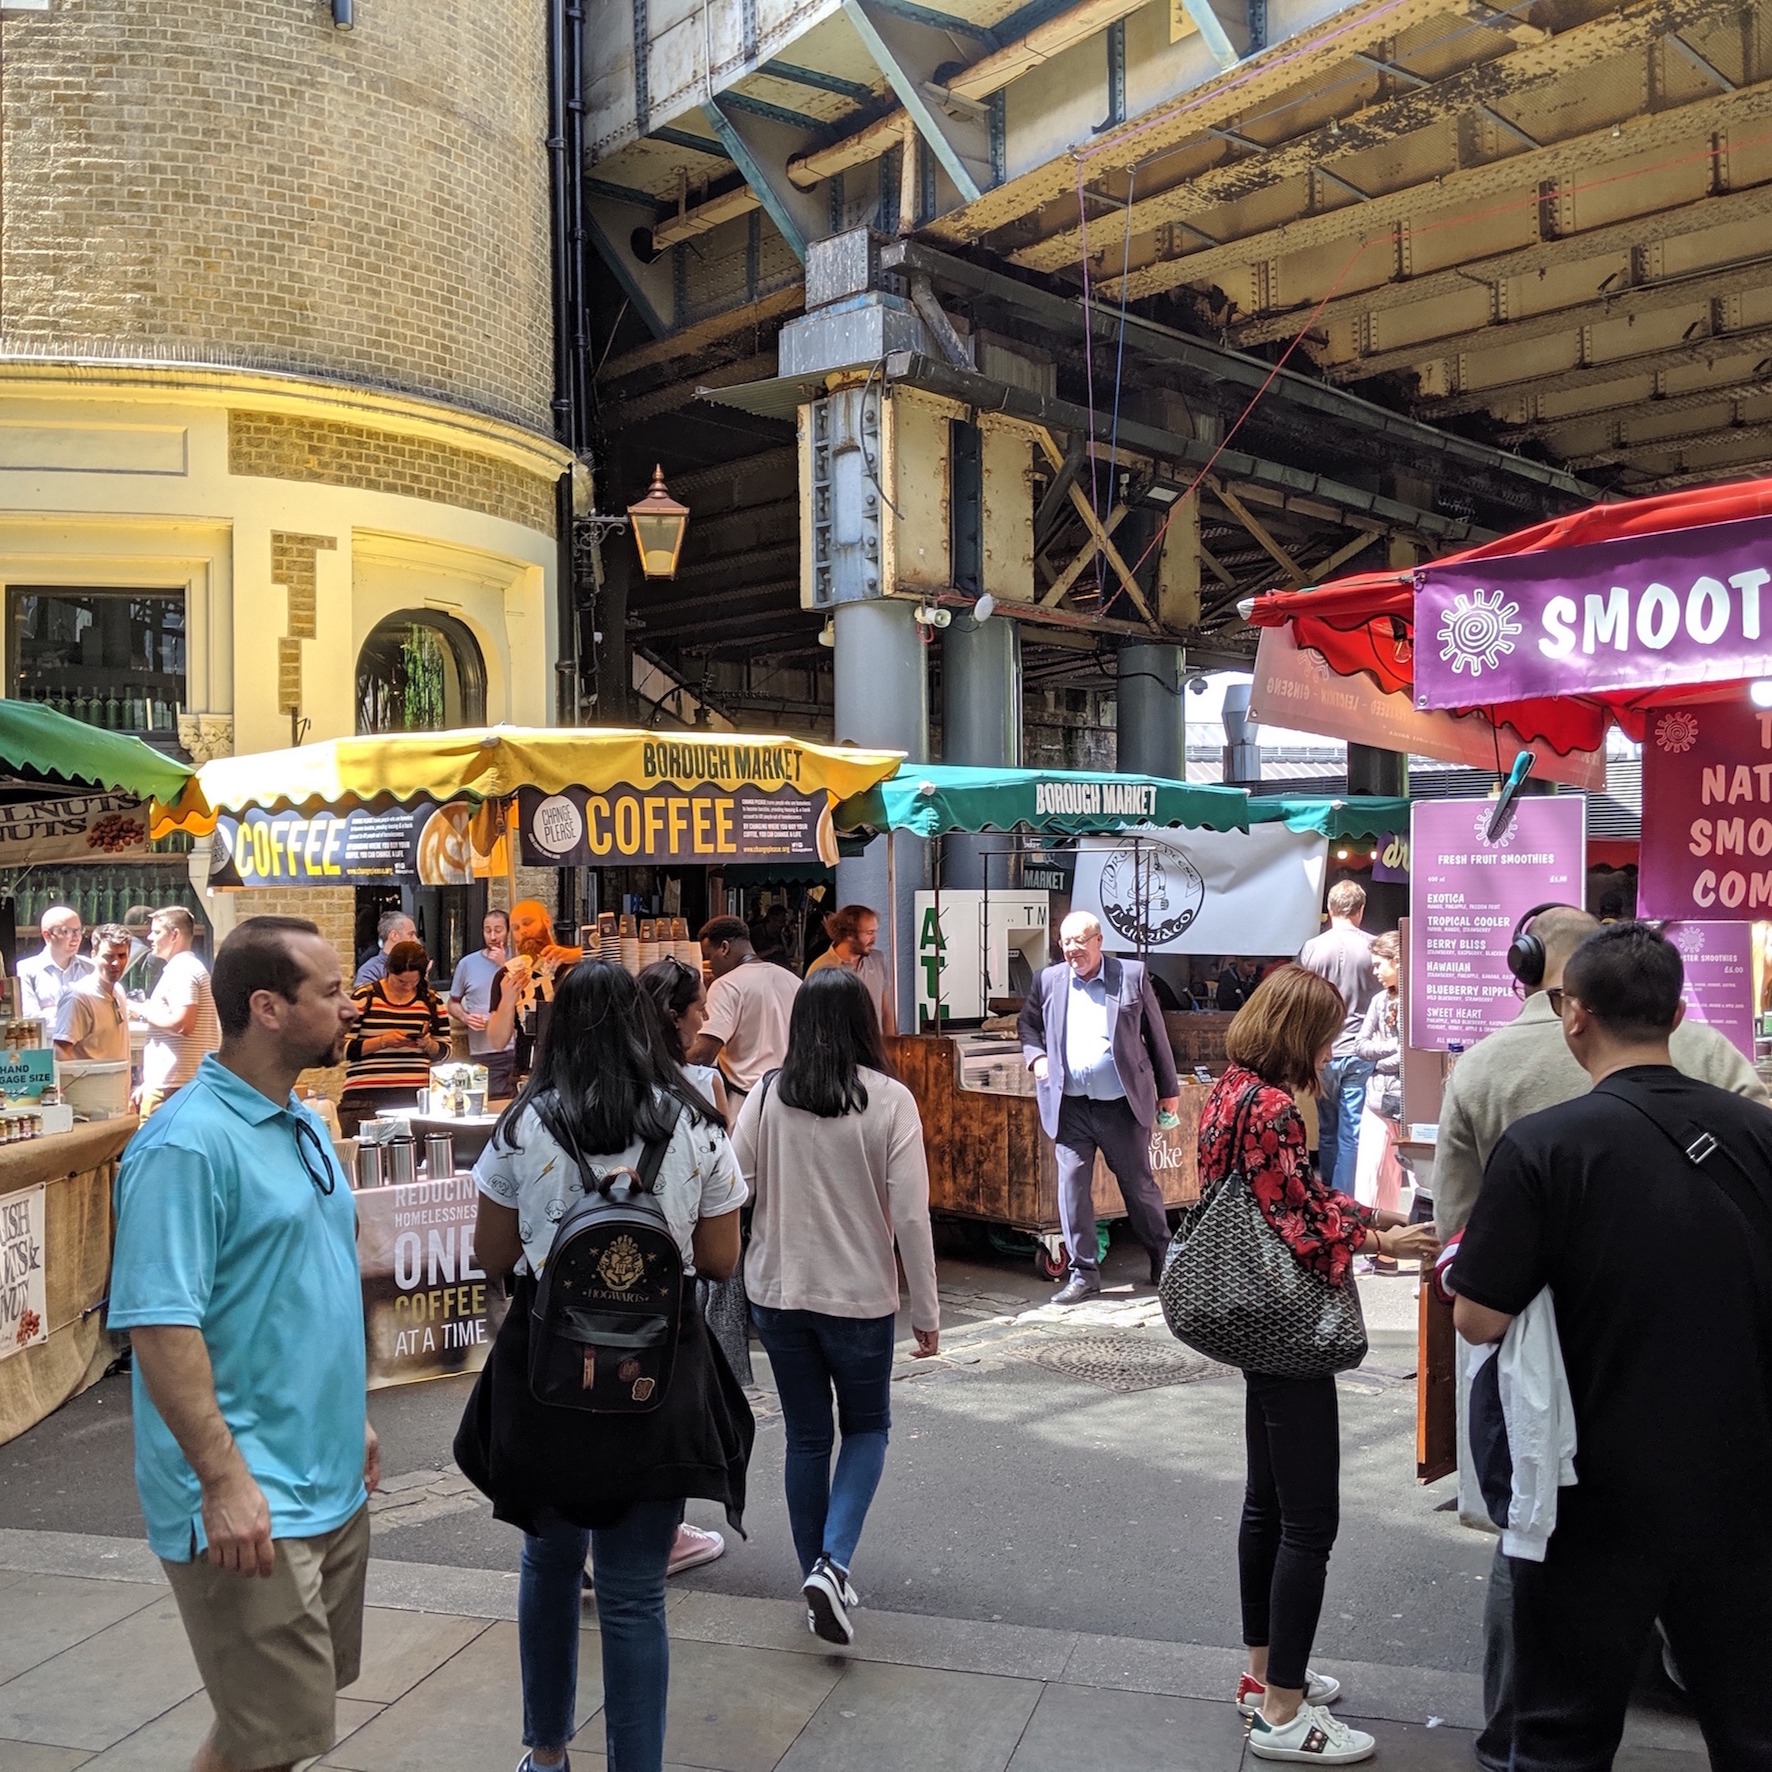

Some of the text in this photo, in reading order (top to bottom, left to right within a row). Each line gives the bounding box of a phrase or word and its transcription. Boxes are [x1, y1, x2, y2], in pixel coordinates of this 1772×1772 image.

[1538, 568, 1771, 659] SMOOT
[643, 742, 803, 782] BOROUGH MARKET
[1701, 764, 1772, 806] NAT
[1036, 783, 1157, 815] BOROUGH MARKET
[541, 804, 572, 826] CHANGE
[585, 795, 737, 856] COFFEE
[0, 818, 87, 842] UTS
[544, 821, 576, 844] PLEASE
[1689, 817, 1772, 857] SMO
[234, 819, 346, 878] COFFEE
[1438, 853, 1555, 864] FRESH FRUIT SMOOTHIES
[1023, 869, 1065, 891] MARKET
[1692, 868, 1772, 909] COM
[1427, 893, 1464, 903] EXOTICA
[1427, 916, 1510, 927] TROPICAL COOLER
[1427, 939, 1486, 949] BERRY BLISS
[1427, 961, 1471, 972] HAWAIIAN
[1681, 954, 1738, 962] STER SMOOTHIES
[1426, 985, 1514, 997] BLUEBERRY RIPPLE
[1427, 1007, 1482, 1019] SWEET HEART
[0, 1064, 29, 1074] HAND
[29, 1073, 50, 1082] SIZE
[1151, 1131, 1163, 1149] &
[1148, 1140, 1183, 1170] oke
[395, 1178, 479, 1207] REDUCIN
[395, 1205, 477, 1228] HOMELESSNES
[394, 1224, 487, 1291] ONE
[394, 1284, 487, 1324] COFFEE
[395, 1319, 488, 1357] AT A TIME
